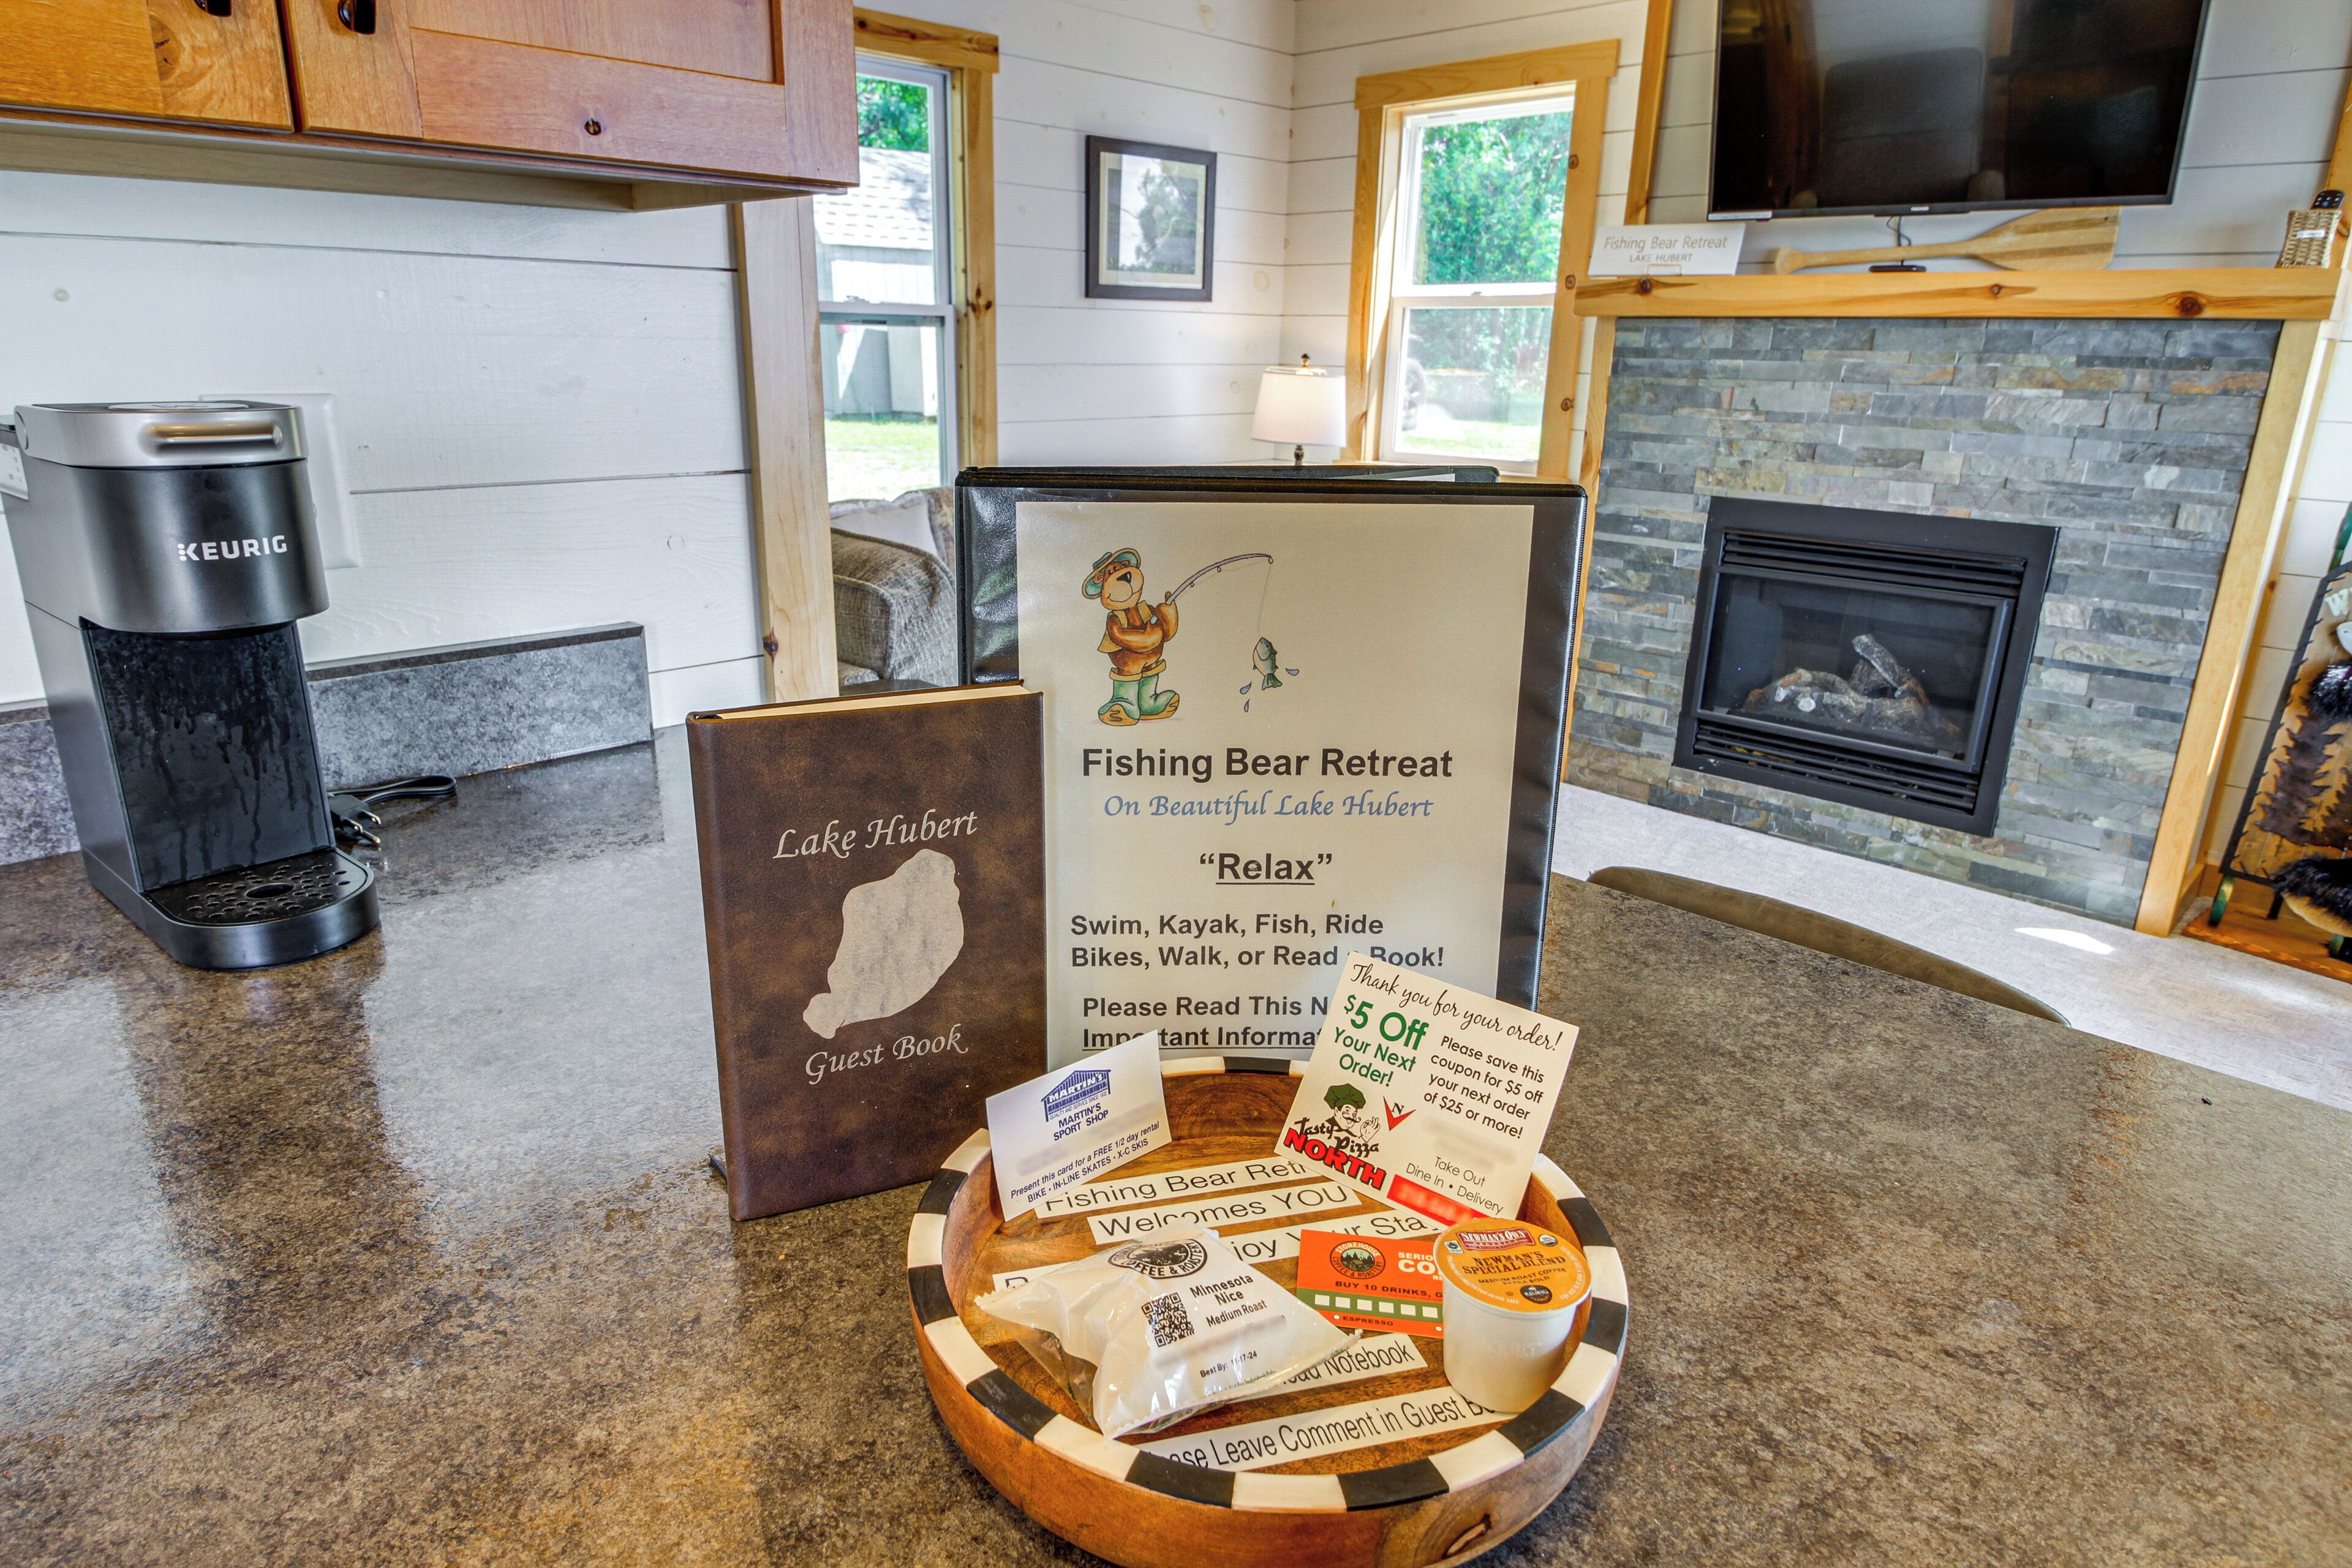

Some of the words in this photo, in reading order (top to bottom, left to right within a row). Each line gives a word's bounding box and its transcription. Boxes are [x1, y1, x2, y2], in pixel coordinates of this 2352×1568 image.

[1604, 237, 1646, 252] Fishing
[1651, 236, 1678, 249] Bear
[1682, 235, 1728, 249] Retreat
[1629, 254, 1652, 262] LAKE
[1656, 253, 1693, 262] HUBERT
[177, 535, 287, 561] KEURIG
[1082, 748, 1213, 783] Fishing
[1225, 748, 1310, 777] Bear
[1320, 748, 1453, 777] Retreat
[1104, 795, 1140, 816] On
[1149, 790, 1273, 826] Beautiful
[1273, 790, 1333, 816] Lake
[1342, 789, 1434, 816] Hubert
[773, 820, 856, 859] Lake
[865, 809, 978, 849] Hubert
[1070, 915, 1150, 938] Swim,
[1159, 914, 1246, 938] Kayak,
[1255, 914, 1316, 937] Fish,
[1325, 914, 1384, 935] Ride
[1071, 947, 1150, 970] Bikes,
[1158, 946, 1229, 970] Walk,
[1237, 950, 1265, 966] or
[1273, 946, 1338, 966] Read
[1370, 946, 1444, 967] Book!
[1084, 997, 1167, 1017] Please
[1176, 997, 1240, 1016] Read
[1249, 996, 1302, 1016] This
[1351, 963, 1400, 996] Thank
[1399, 989, 1432, 1008] you
[1433, 990, 1460, 1016] for
[1460, 1010, 1503, 1032] your
[1507, 1023, 1563, 1051] order!
[1344, 994, 1374, 1029] $5
[1379, 1012, 1430, 1050] Off
[1218, 1027, 1322, 1046] Informa
[1334, 1027, 1371, 1054] Your
[1373, 1043, 1416, 1072] Next
[805, 1044, 884, 1085] Guest
[893, 1023, 969, 1061] Book
[1441, 1035, 1483, 1060] Please
[1486, 1054, 1518, 1073] save
[1521, 1065, 1544, 1084] this
[1340, 1054, 1394, 1087] Order!
[1431, 1055, 1481, 1080] coupon
[1483, 1072, 1502, 1088] for
[1505, 1080, 1523, 1095] $5
[1525, 1090, 1544, 1104] off
[1049, 1072, 1103, 1102] MARTIN'S
[1428, 1074, 1459, 1091] your
[1461, 1087, 1491, 1104] next
[1493, 1099, 1531, 1120] order
[1049, 1110, 1065, 1120] QUALITY
[1058, 1102, 1101, 1128] MARTIN'S
[1391, 1102, 1404, 1115] N
[1424, 1093, 1438, 1104] of
[1439, 1096, 1463, 1114] $25
[1466, 1109, 1480, 1121] or
[1482, 1115, 1523, 1139] more!
[1054, 1122, 1082, 1141] SPORT
[1086, 1109, 1109, 1126] SHOP
[1294, 1117, 1334, 1139] Tasty
[1011, 1179, 1040, 1199] Present
[1042, 1173, 1055, 1184] this
[1058, 1162, 1073, 1176] card
[1076, 1158, 1086, 1170] for
[1093, 1144, 1112, 1159] FREE
[1115, 1137, 1125, 1148] 1/2
[1126, 1132, 1139, 1144] day
[1140, 1121, 1159, 1136] rental
[1284, 1128, 1387, 1191] NORTH
[1333, 1136, 1379, 1158] Pizza
[1028, 1188, 1047, 1203] BIKE
[1053, 1173, 1080, 1191] IN-LINE
[1082, 1156, 1111, 1176] SKATES
[1117, 1147, 1130, 1159] X-C
[1131, 1138, 1148, 1152] SKIS
[1434, 1156, 1460, 1176] Take
[1463, 1170, 1486, 1187] Out
[1046, 1183, 1157, 1212] Fishing
[1165, 1170, 1236, 1193] Bear
[1272, 1185, 1348, 1210] YOU
[1406, 1163, 1431, 1182] Dine
[1434, 1175, 1444, 1188] In
[1457, 1185, 1504, 1215] Delivery
[1231, 1239, 1277, 1261] joy
[1370, 1216, 1439, 1235] Sta
[1335, 1242, 1381, 1257] STONEHOUSE
[1332, 1256, 1349, 1275] COFFEE
[1357, 1261, 1382, 1278] ROASTERY
[1398, 1251, 1433, 1261] SERIO
[1462, 1262, 1521, 1275] SPECIAL
[1523, 1256, 1566, 1268] BLEND
[1472, 1251, 1544, 1267] NEWMAN'S
[1189, 1275, 1254, 1298] Minnesota
[1511, 1273, 1537, 1281] ROAST
[1539, 1267, 1567, 1276] COFFEE
[1214, 1291, 1244, 1306] Nice
[1335, 1281, 1359, 1289] BUY
[1382, 1286, 1431, 1298] DRINKS,
[1205, 1309, 1243, 1328] Medium
[1241, 1300, 1267, 1315] Roast
[1343, 1316, 1393, 1326] ESPRESSO
[1200, 1364, 1216, 1378] Best
[1217, 1362, 1229, 1371] By:
[1231, 1351, 1257, 1366] 11-17-24
[1324, 1340, 1415, 1376] Notebook
[1210, 1433, 1278, 1465] Leave
[1278, 1412, 1381, 1452] Comment
[1378, 1406, 1403, 1432] in
[1401, 1395, 1466, 1428] Guest
